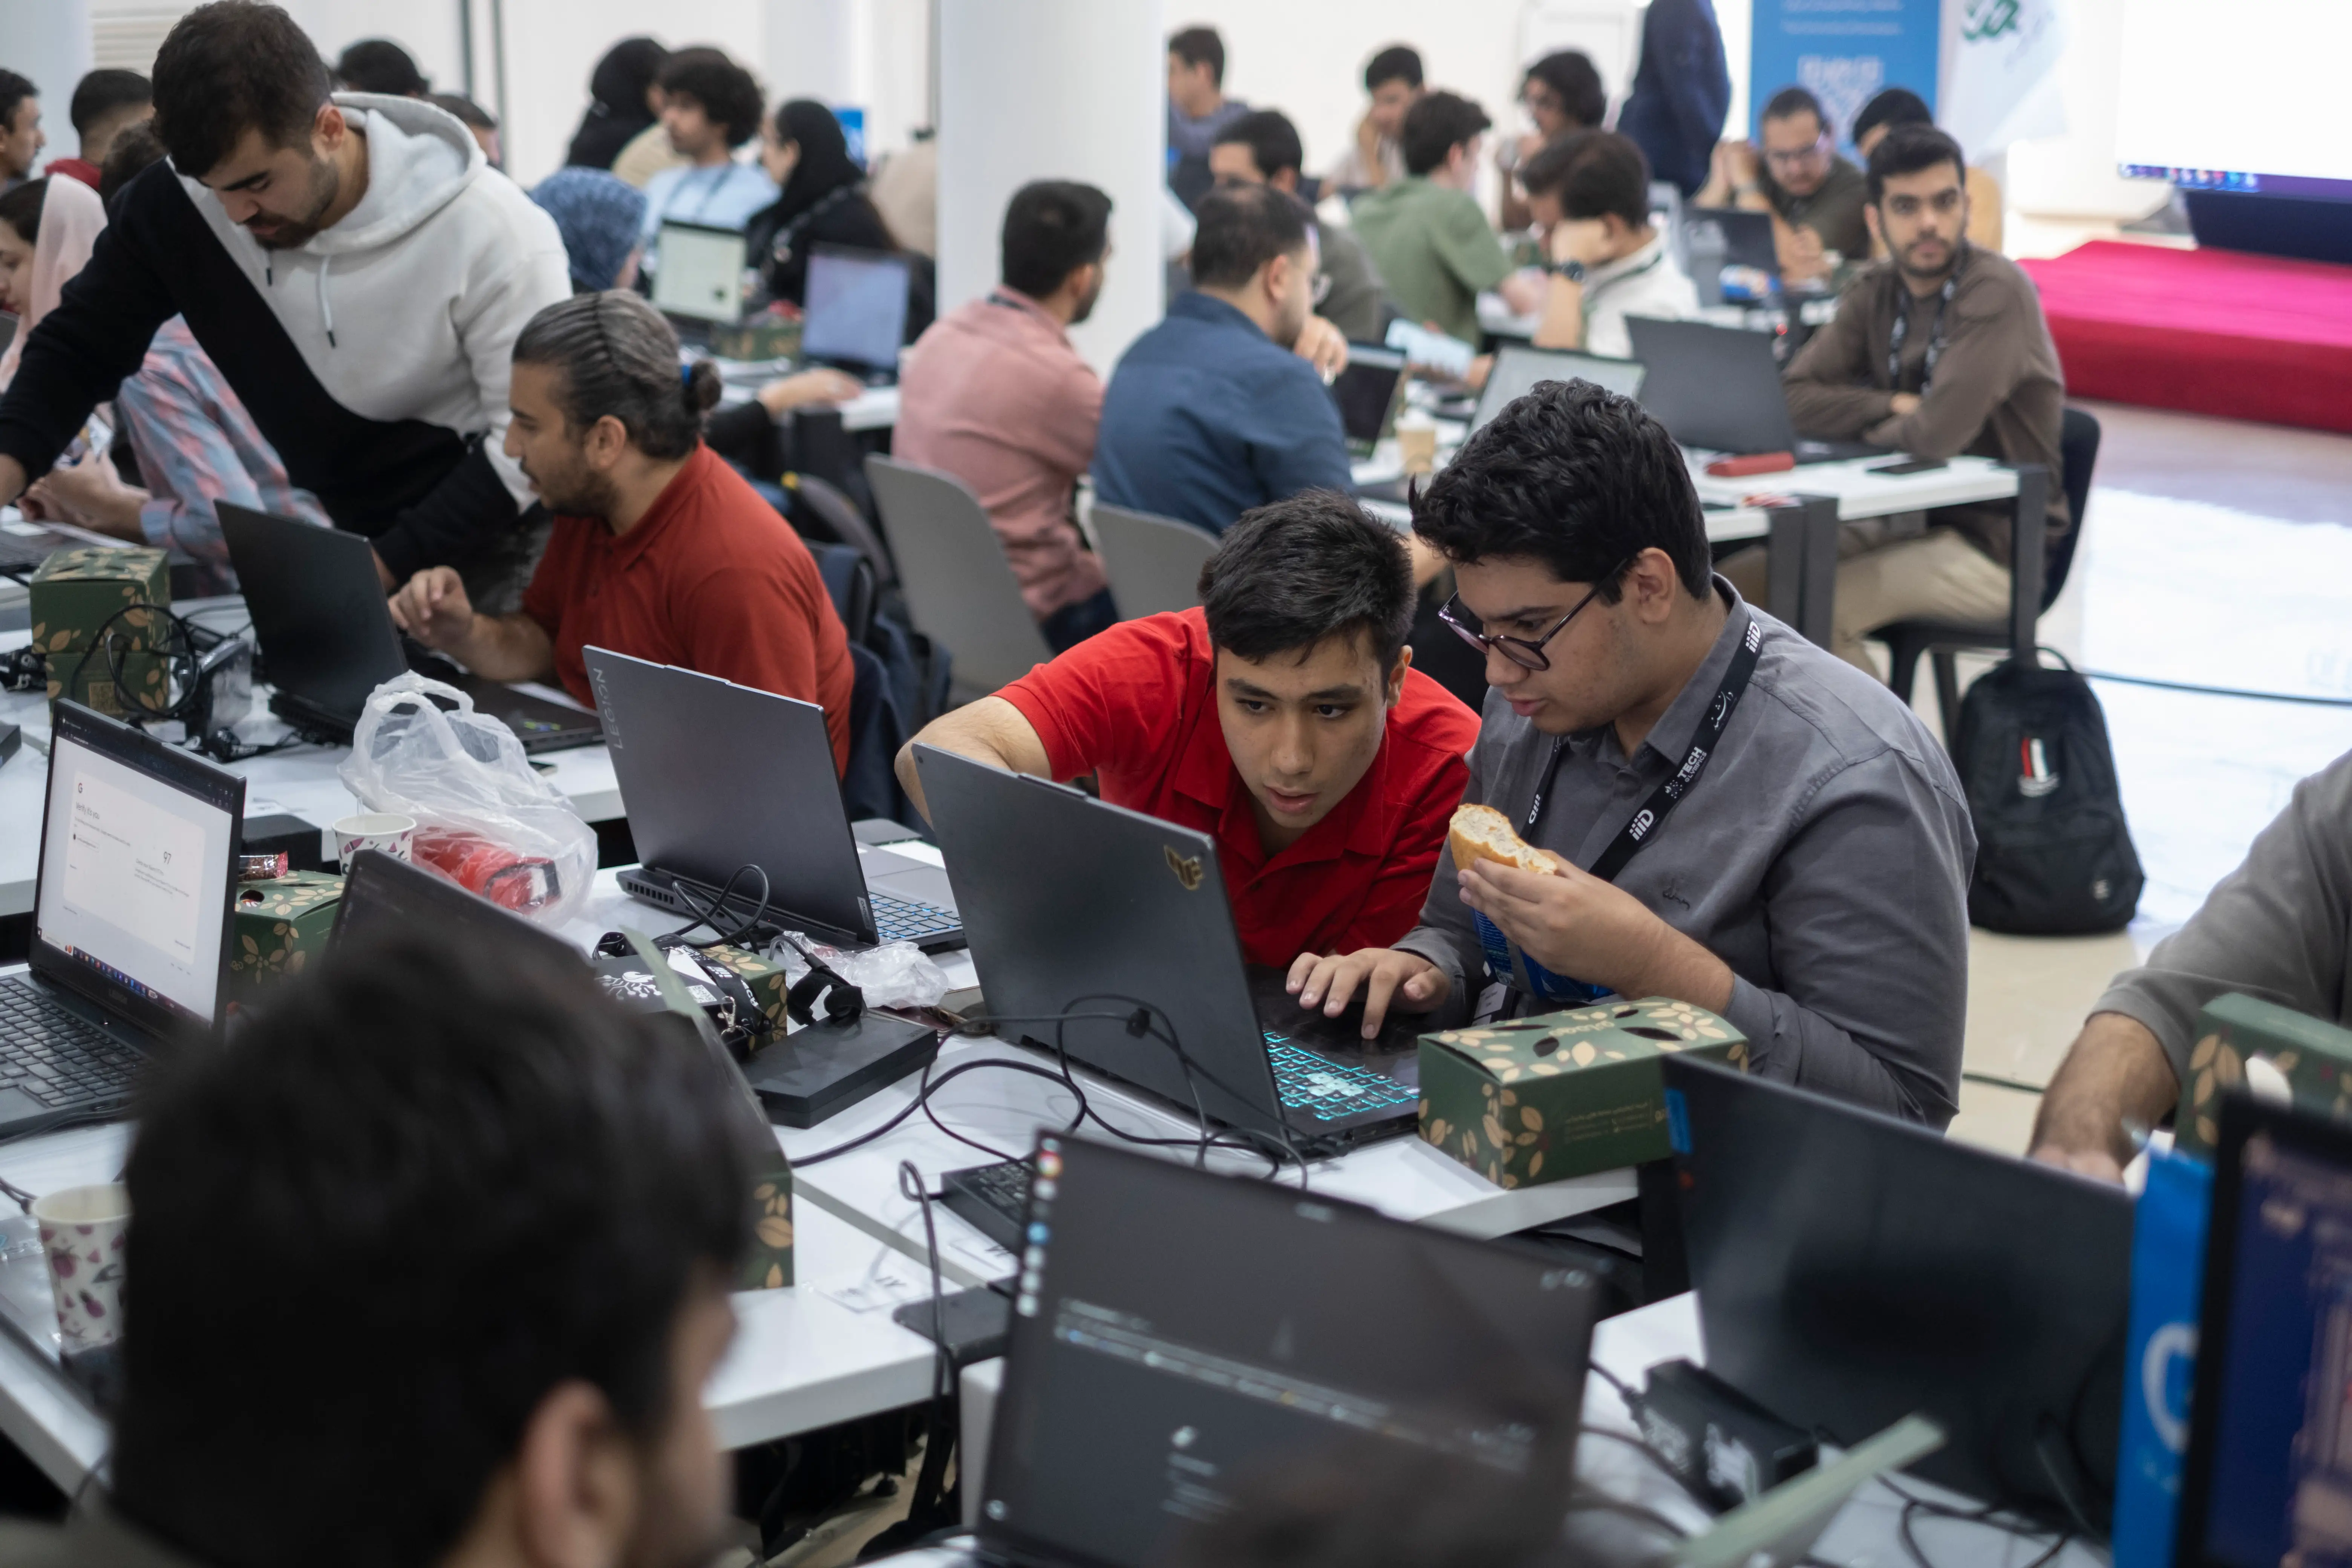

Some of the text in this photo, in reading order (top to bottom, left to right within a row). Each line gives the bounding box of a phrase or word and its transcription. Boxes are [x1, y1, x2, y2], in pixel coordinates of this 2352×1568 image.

[593, 668, 623, 749] LEGION
[1677, 747, 1703, 778] TECH
[1684, 752, 1707, 782] OLYMPICS
[164, 851, 172, 864] 97
